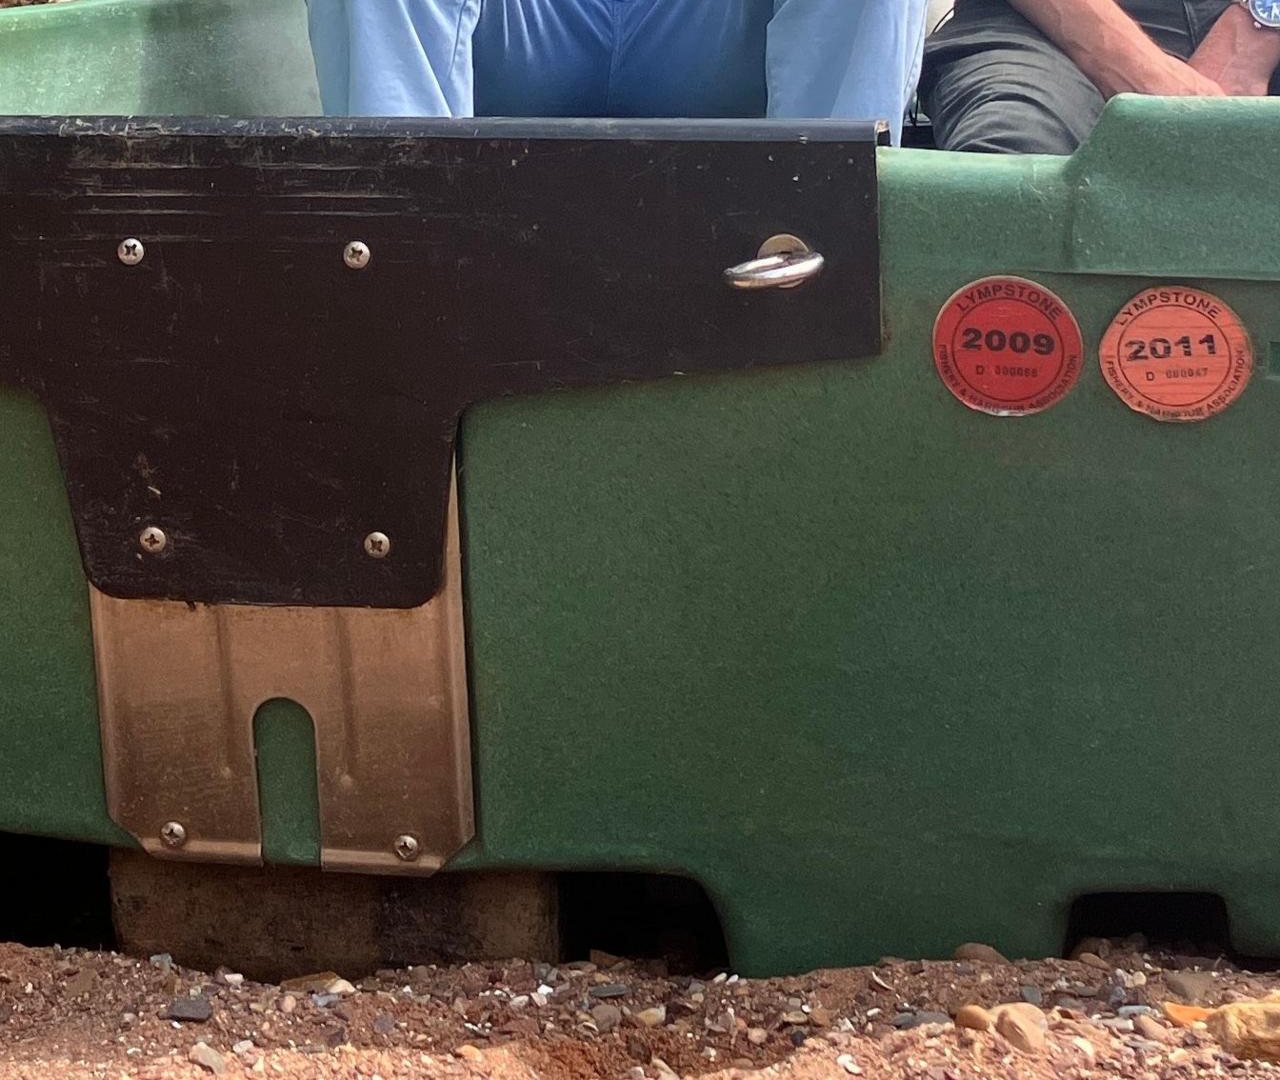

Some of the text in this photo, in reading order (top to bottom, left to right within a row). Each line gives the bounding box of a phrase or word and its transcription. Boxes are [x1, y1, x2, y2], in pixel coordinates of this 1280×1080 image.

[956, 284, 1062, 321] LYMPSTONE
[1115, 292, 1222, 327] LYMPSTONE
[961, 327, 1056, 355] 2009
[1124, 333, 1217, 362] 2011
[1145, 371, 1156, 382] D
